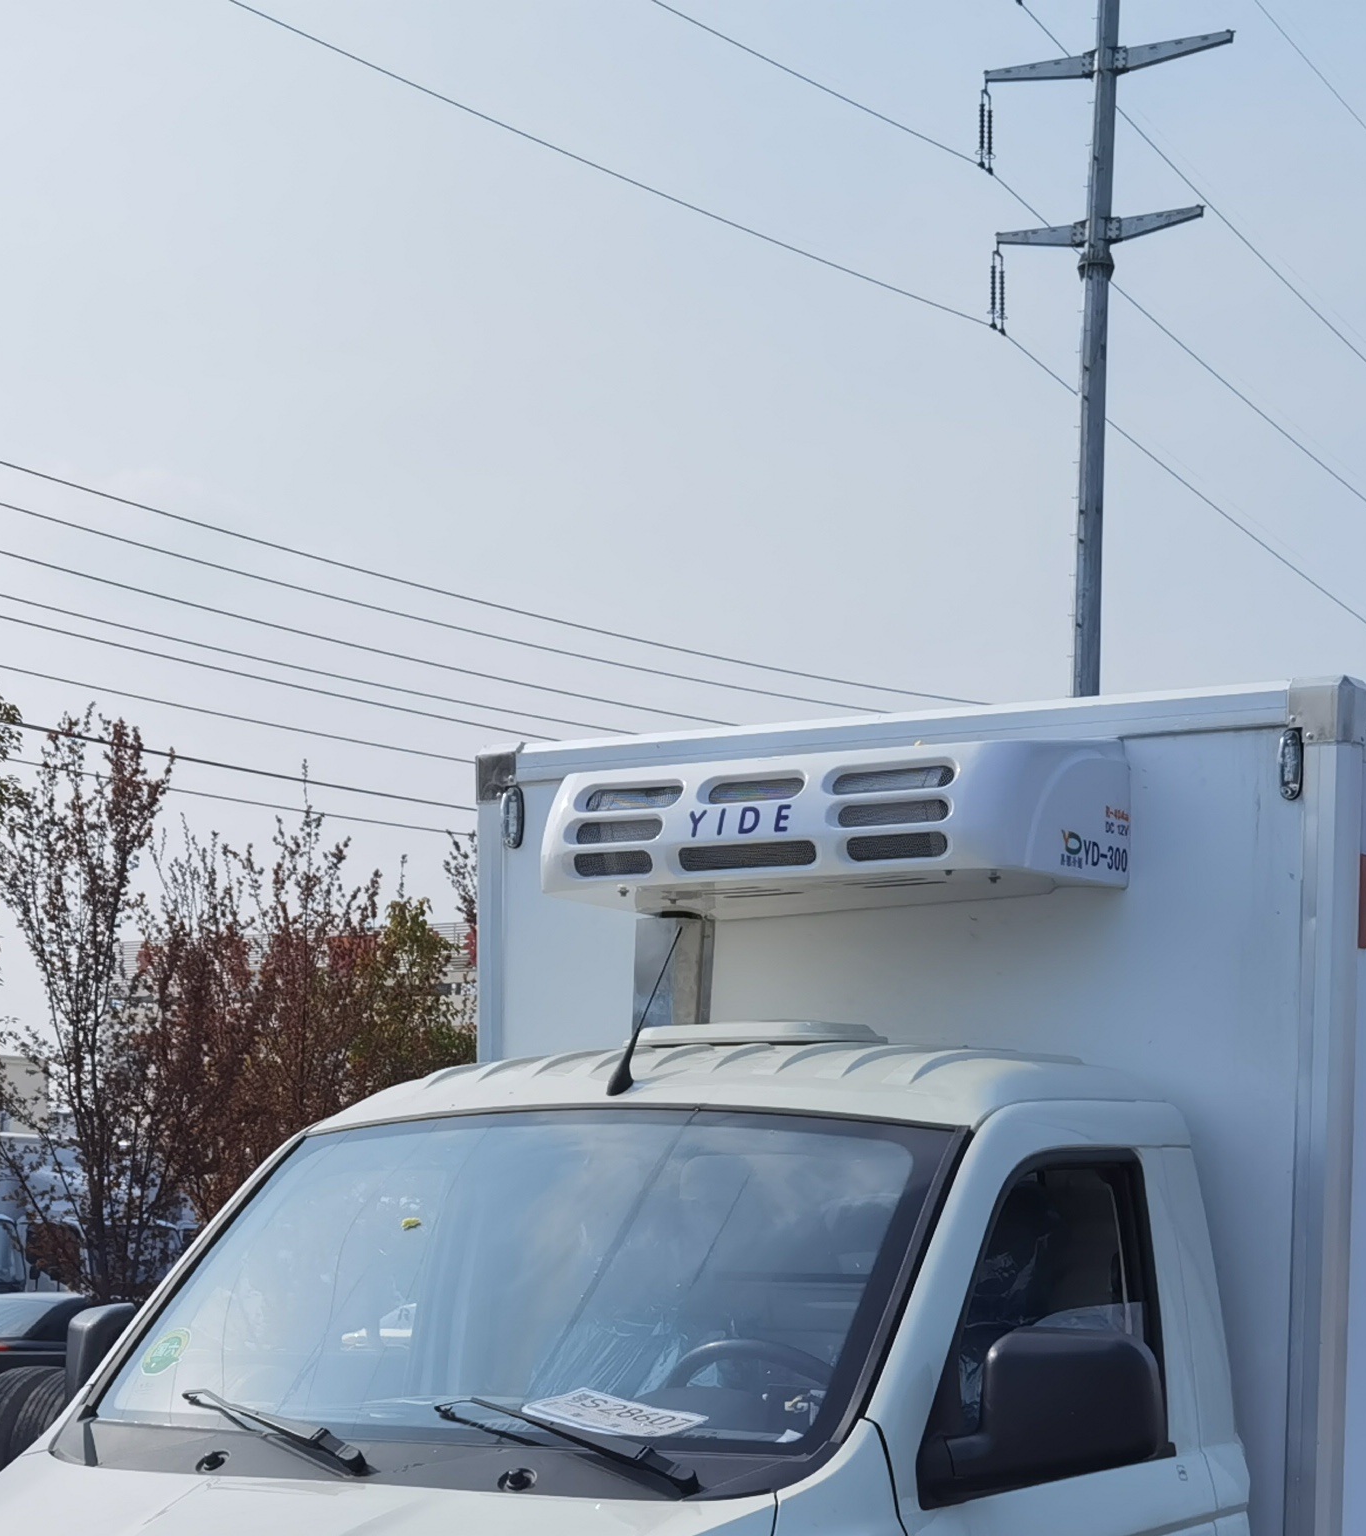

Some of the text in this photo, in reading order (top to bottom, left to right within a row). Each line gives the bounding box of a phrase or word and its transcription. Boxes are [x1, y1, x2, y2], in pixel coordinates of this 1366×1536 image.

[688, 804, 792, 838] YIDE
[1105, 821, 1130, 836] DC 12V
[1083, 839, 1128, 873] YD-300
